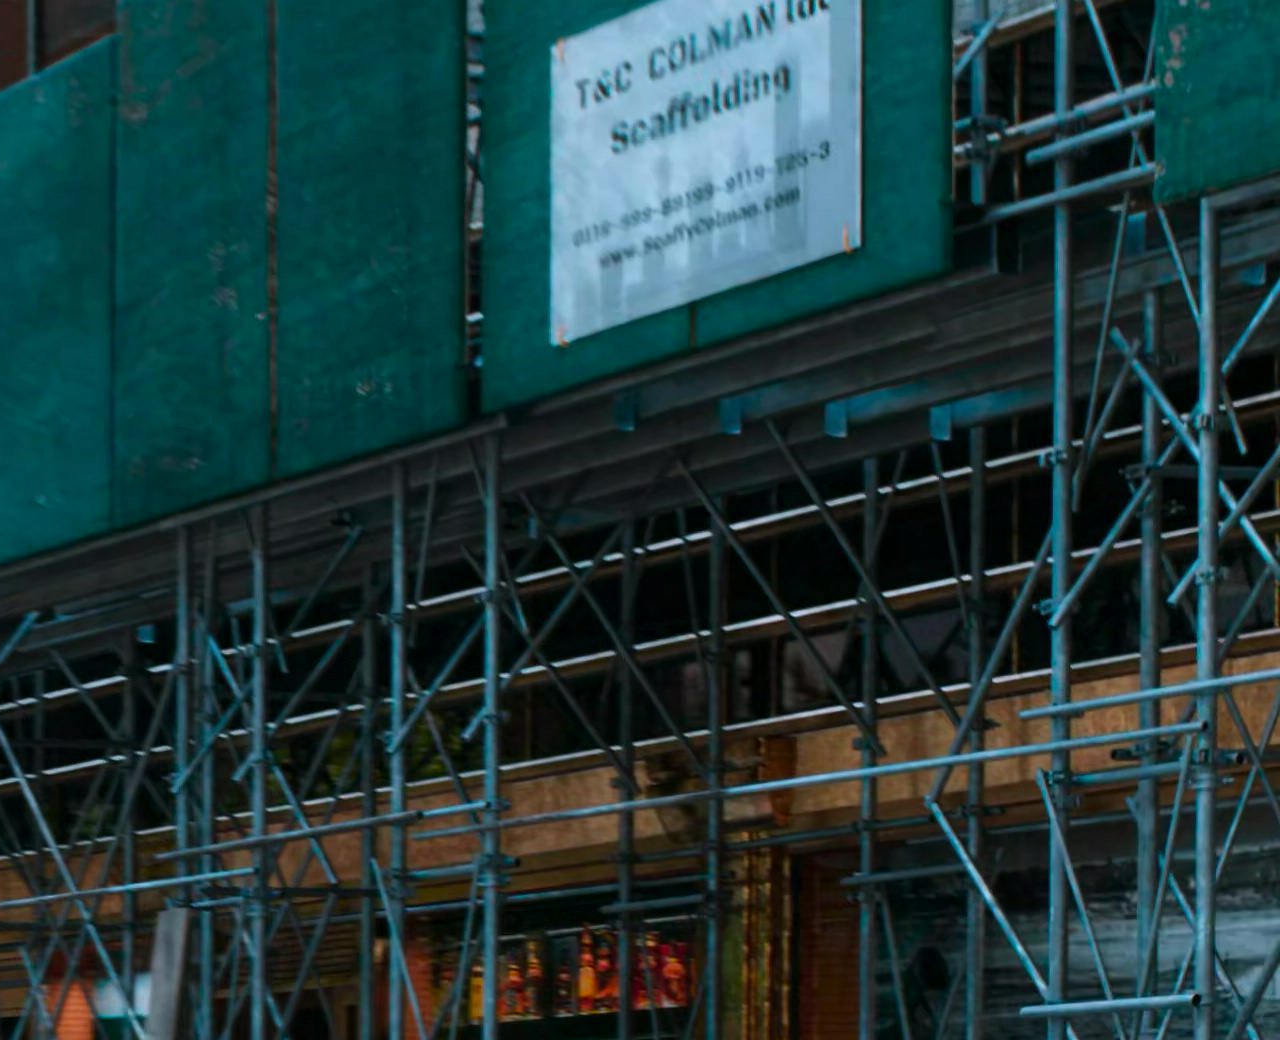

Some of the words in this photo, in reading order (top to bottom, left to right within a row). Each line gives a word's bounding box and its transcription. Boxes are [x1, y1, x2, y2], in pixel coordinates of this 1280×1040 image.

[574, 60, 633, 110] T&C
[647, 1, 777, 82] COLMAN
[609, 60, 792, 155] Scaffolding
